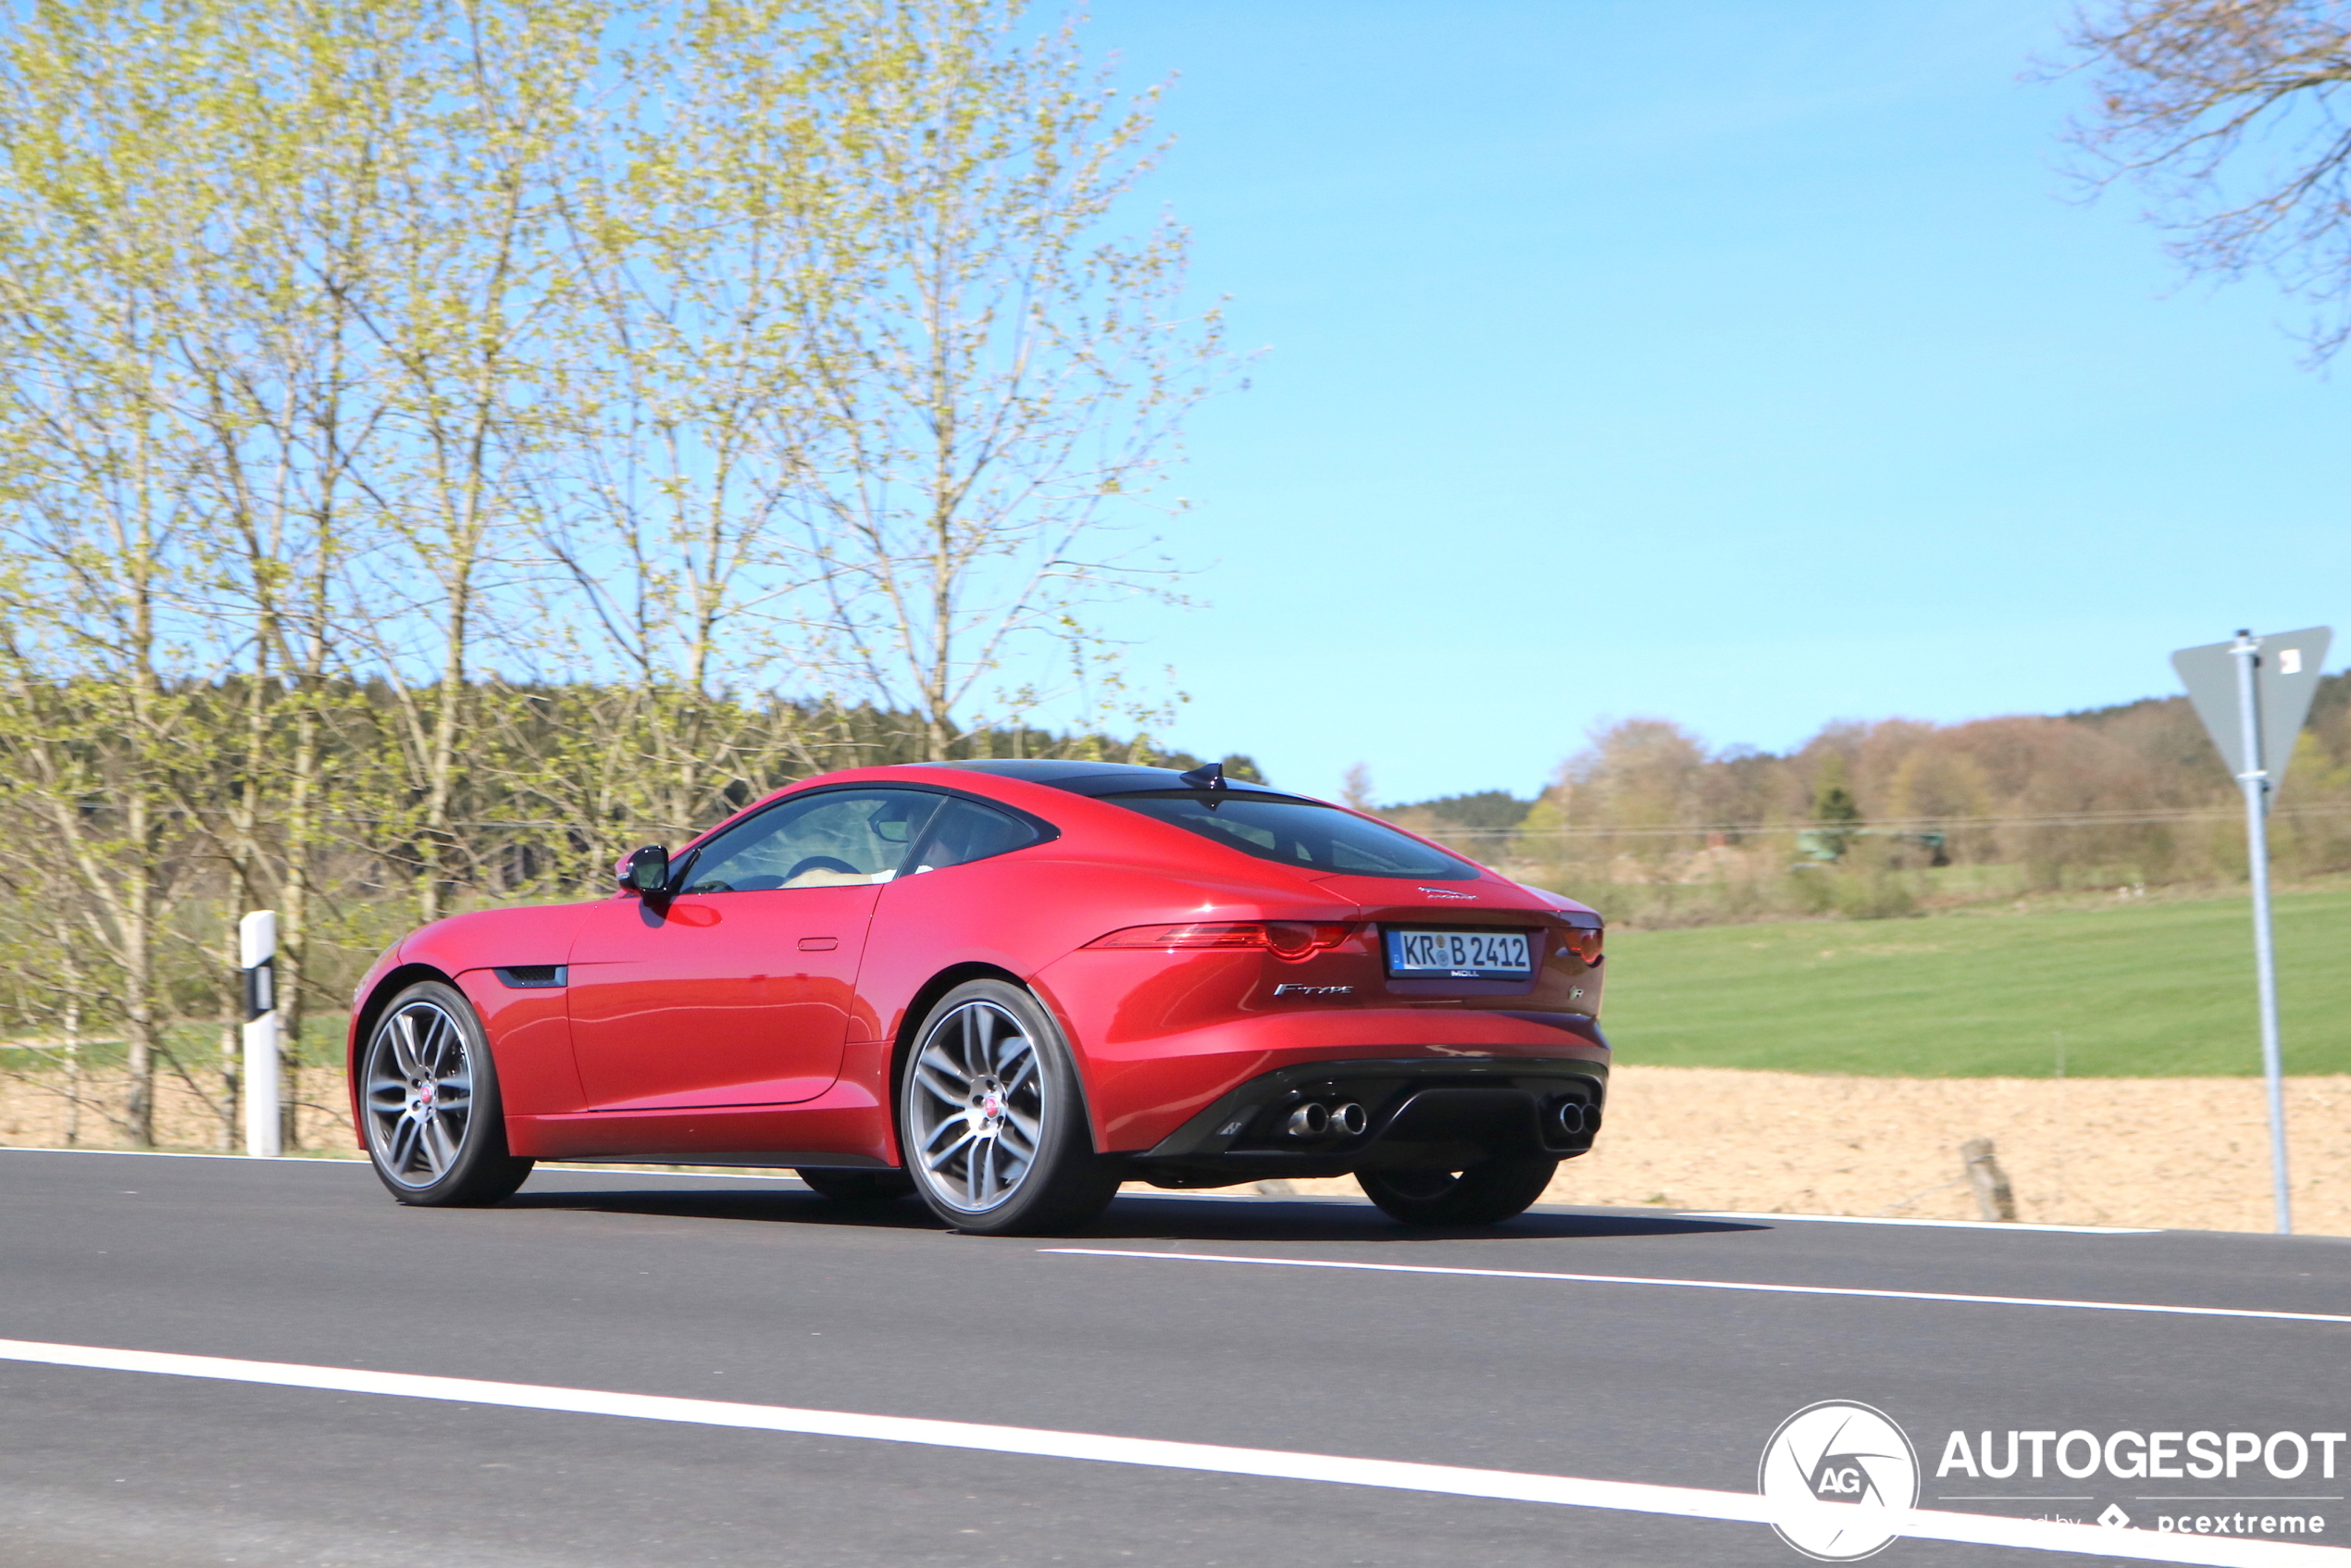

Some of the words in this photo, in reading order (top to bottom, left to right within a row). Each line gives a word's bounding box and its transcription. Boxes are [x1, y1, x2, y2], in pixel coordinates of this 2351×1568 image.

[1403, 935, 1437, 965] KR
[1450, 936, 1466, 965] B
[1471, 937, 1527, 967] 2412
[1450, 969, 1480, 977] MOLL
[1274, 983, 1354, 995] F-TYPE
